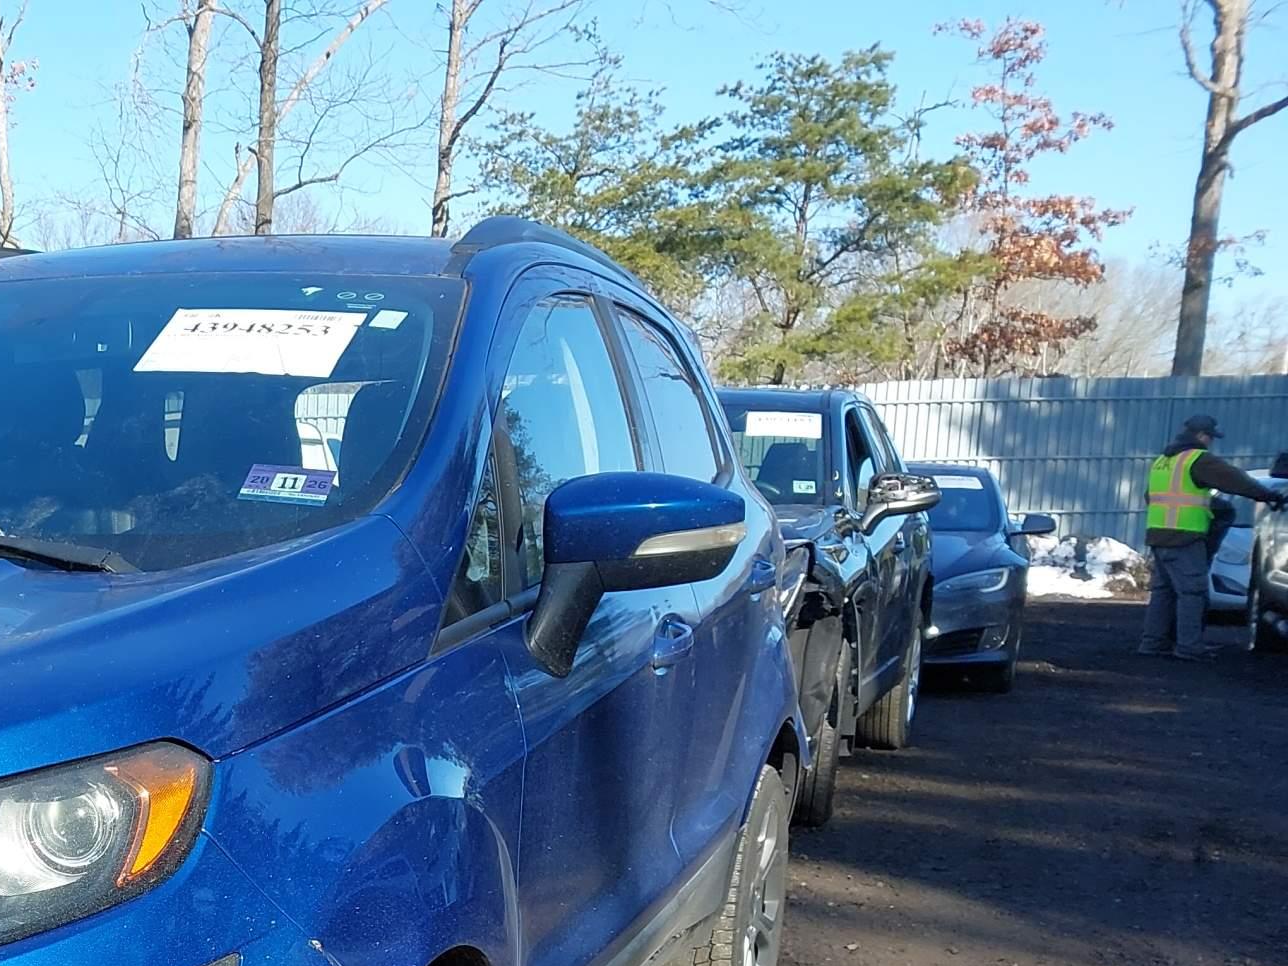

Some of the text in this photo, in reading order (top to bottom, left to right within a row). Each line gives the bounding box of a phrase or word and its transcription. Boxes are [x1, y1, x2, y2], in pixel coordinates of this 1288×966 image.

[183, 322, 331, 336] 43948253
[251, 475, 328, 490] 20 11 26
